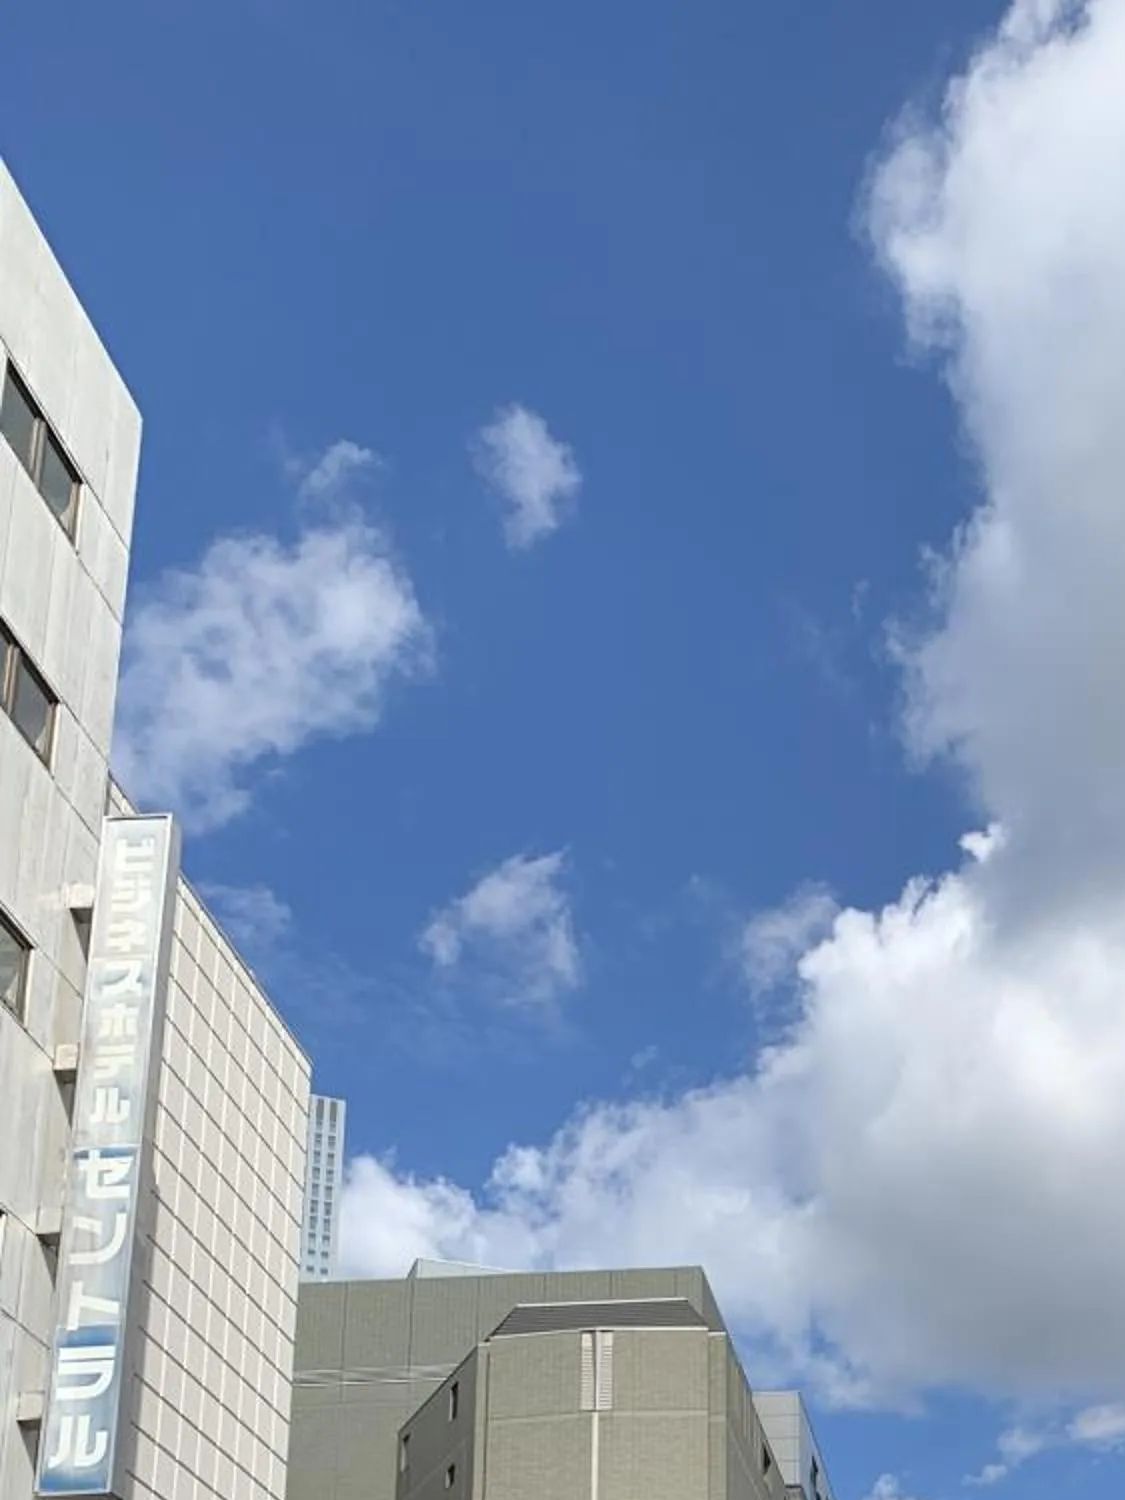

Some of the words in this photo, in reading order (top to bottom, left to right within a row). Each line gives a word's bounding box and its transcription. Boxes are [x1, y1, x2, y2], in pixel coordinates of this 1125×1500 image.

[48, 1149, 133, 1468] セントラル
